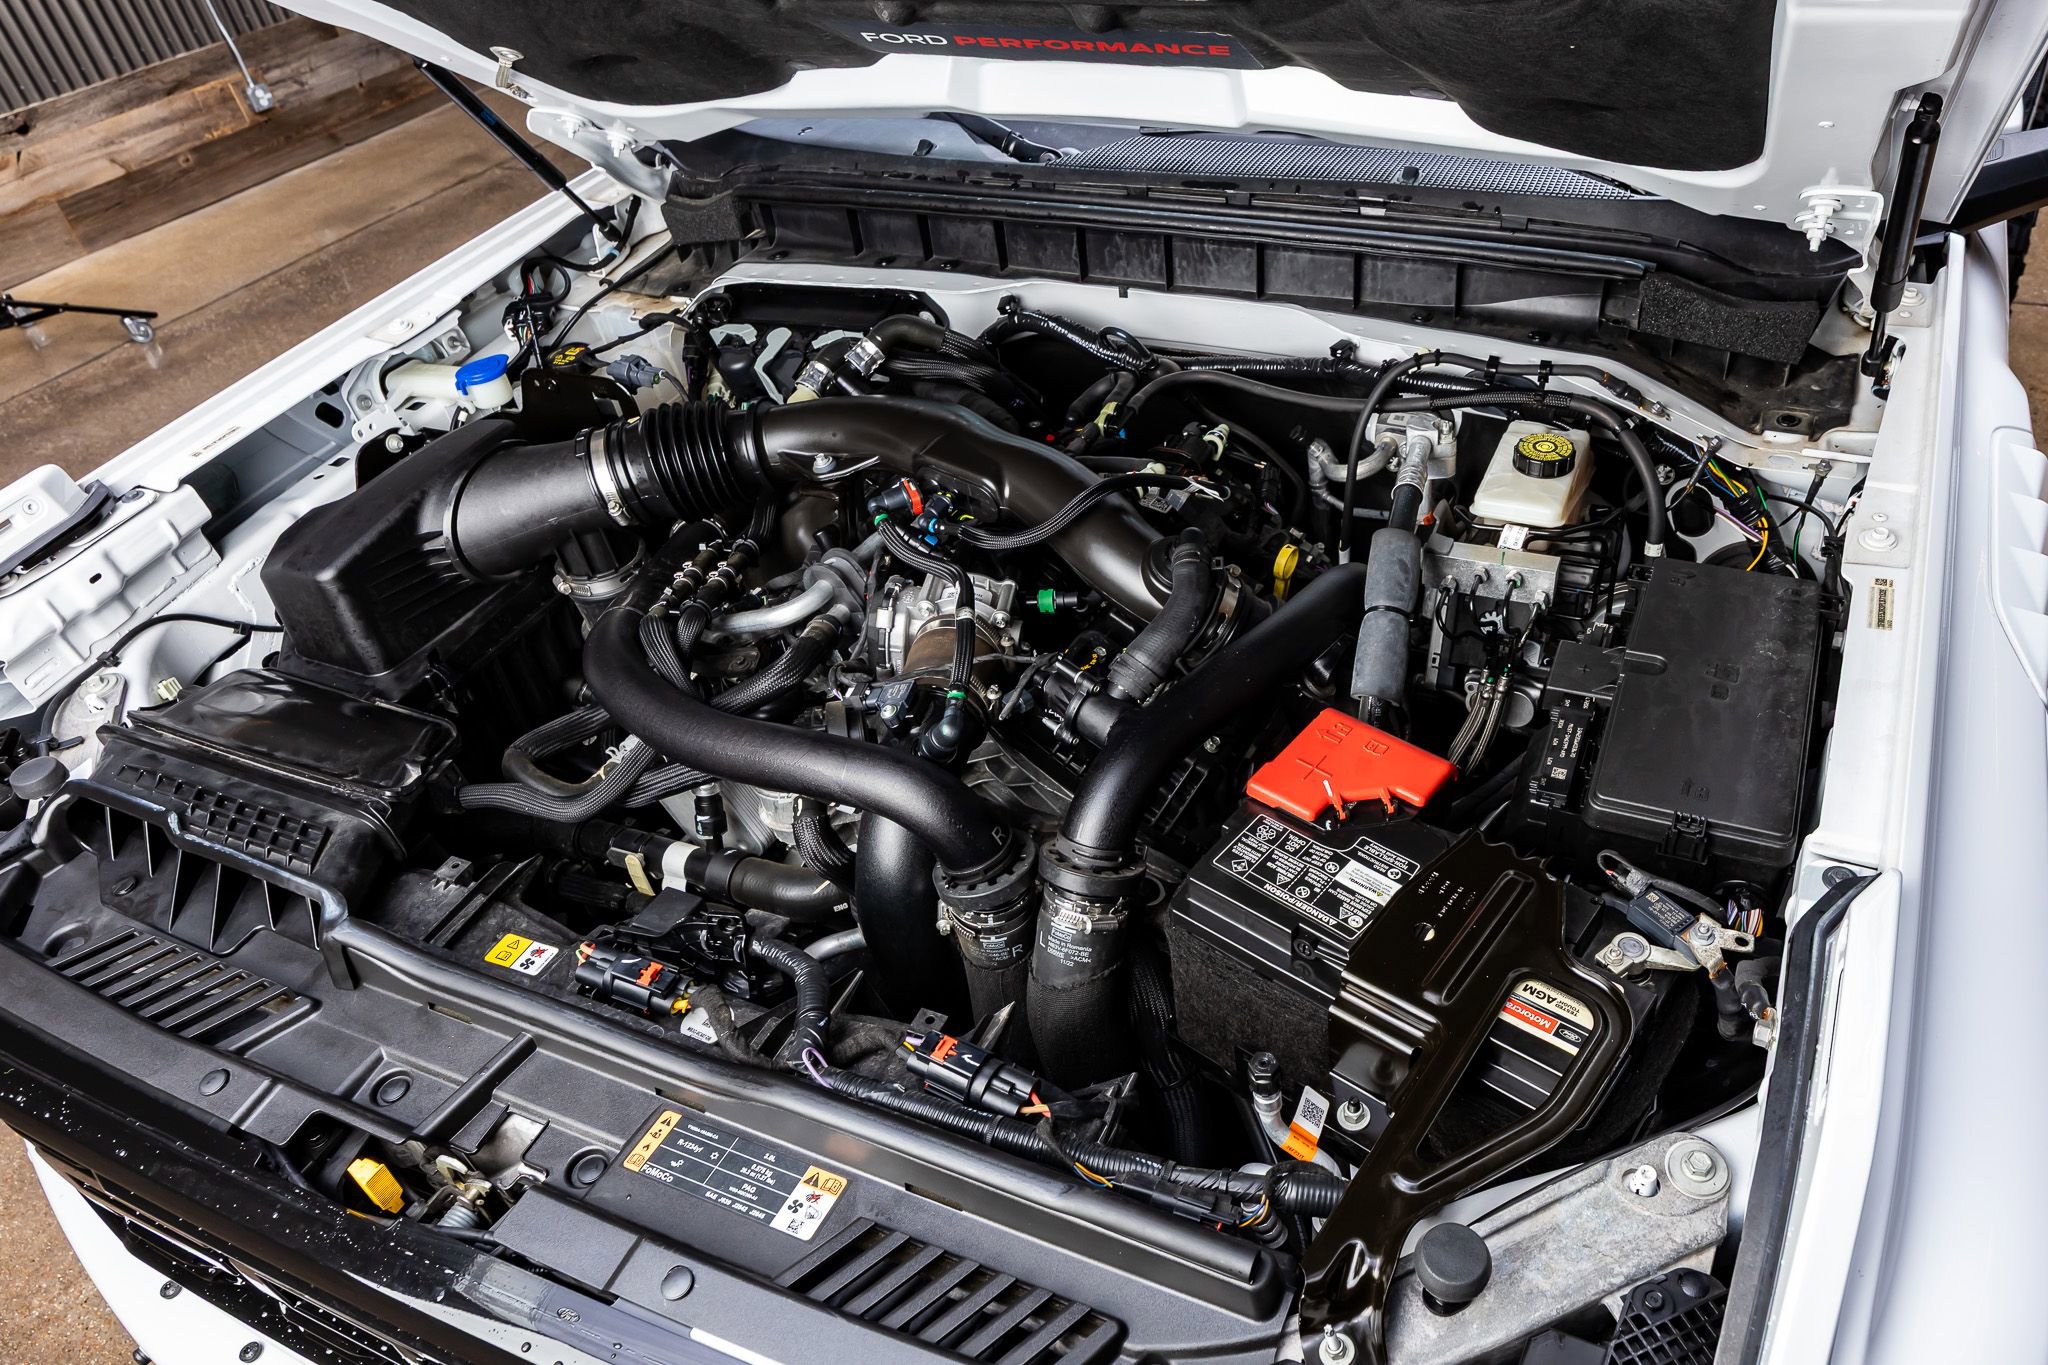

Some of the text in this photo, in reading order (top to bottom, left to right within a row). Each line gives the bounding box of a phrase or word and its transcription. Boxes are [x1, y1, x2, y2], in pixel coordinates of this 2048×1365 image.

[860, 31, 1231, 56] FORD PERFORMANCE
[991, 825, 1007, 845] R
[1286, 833, 1306, 846] OPEN.
[1286, 839, 1300, 848] NOT
[1283, 844, 1295, 852] DO
[1363, 844, 1408, 869] NON-SPILLABLE
[1347, 876, 1377, 894] WARNING:
[833, 902, 848, 912] ENG
[1263, 883, 1330, 922] DANGER/POISON
[1039, 930, 1045, 947] L
[1048, 934, 1060, 944] Made
[1066, 942, 1092, 952] Romania
[1012, 944, 1023, 957] R
[1522, 983, 1557, 1005] AGM
[1503, 1000, 1551, 1029] Motorcra
[675, 1138, 704, 1154] R-1234yf
[639, 1163, 675, 1182] FoMoCo
[740, 1182, 757, 1193] PAG
